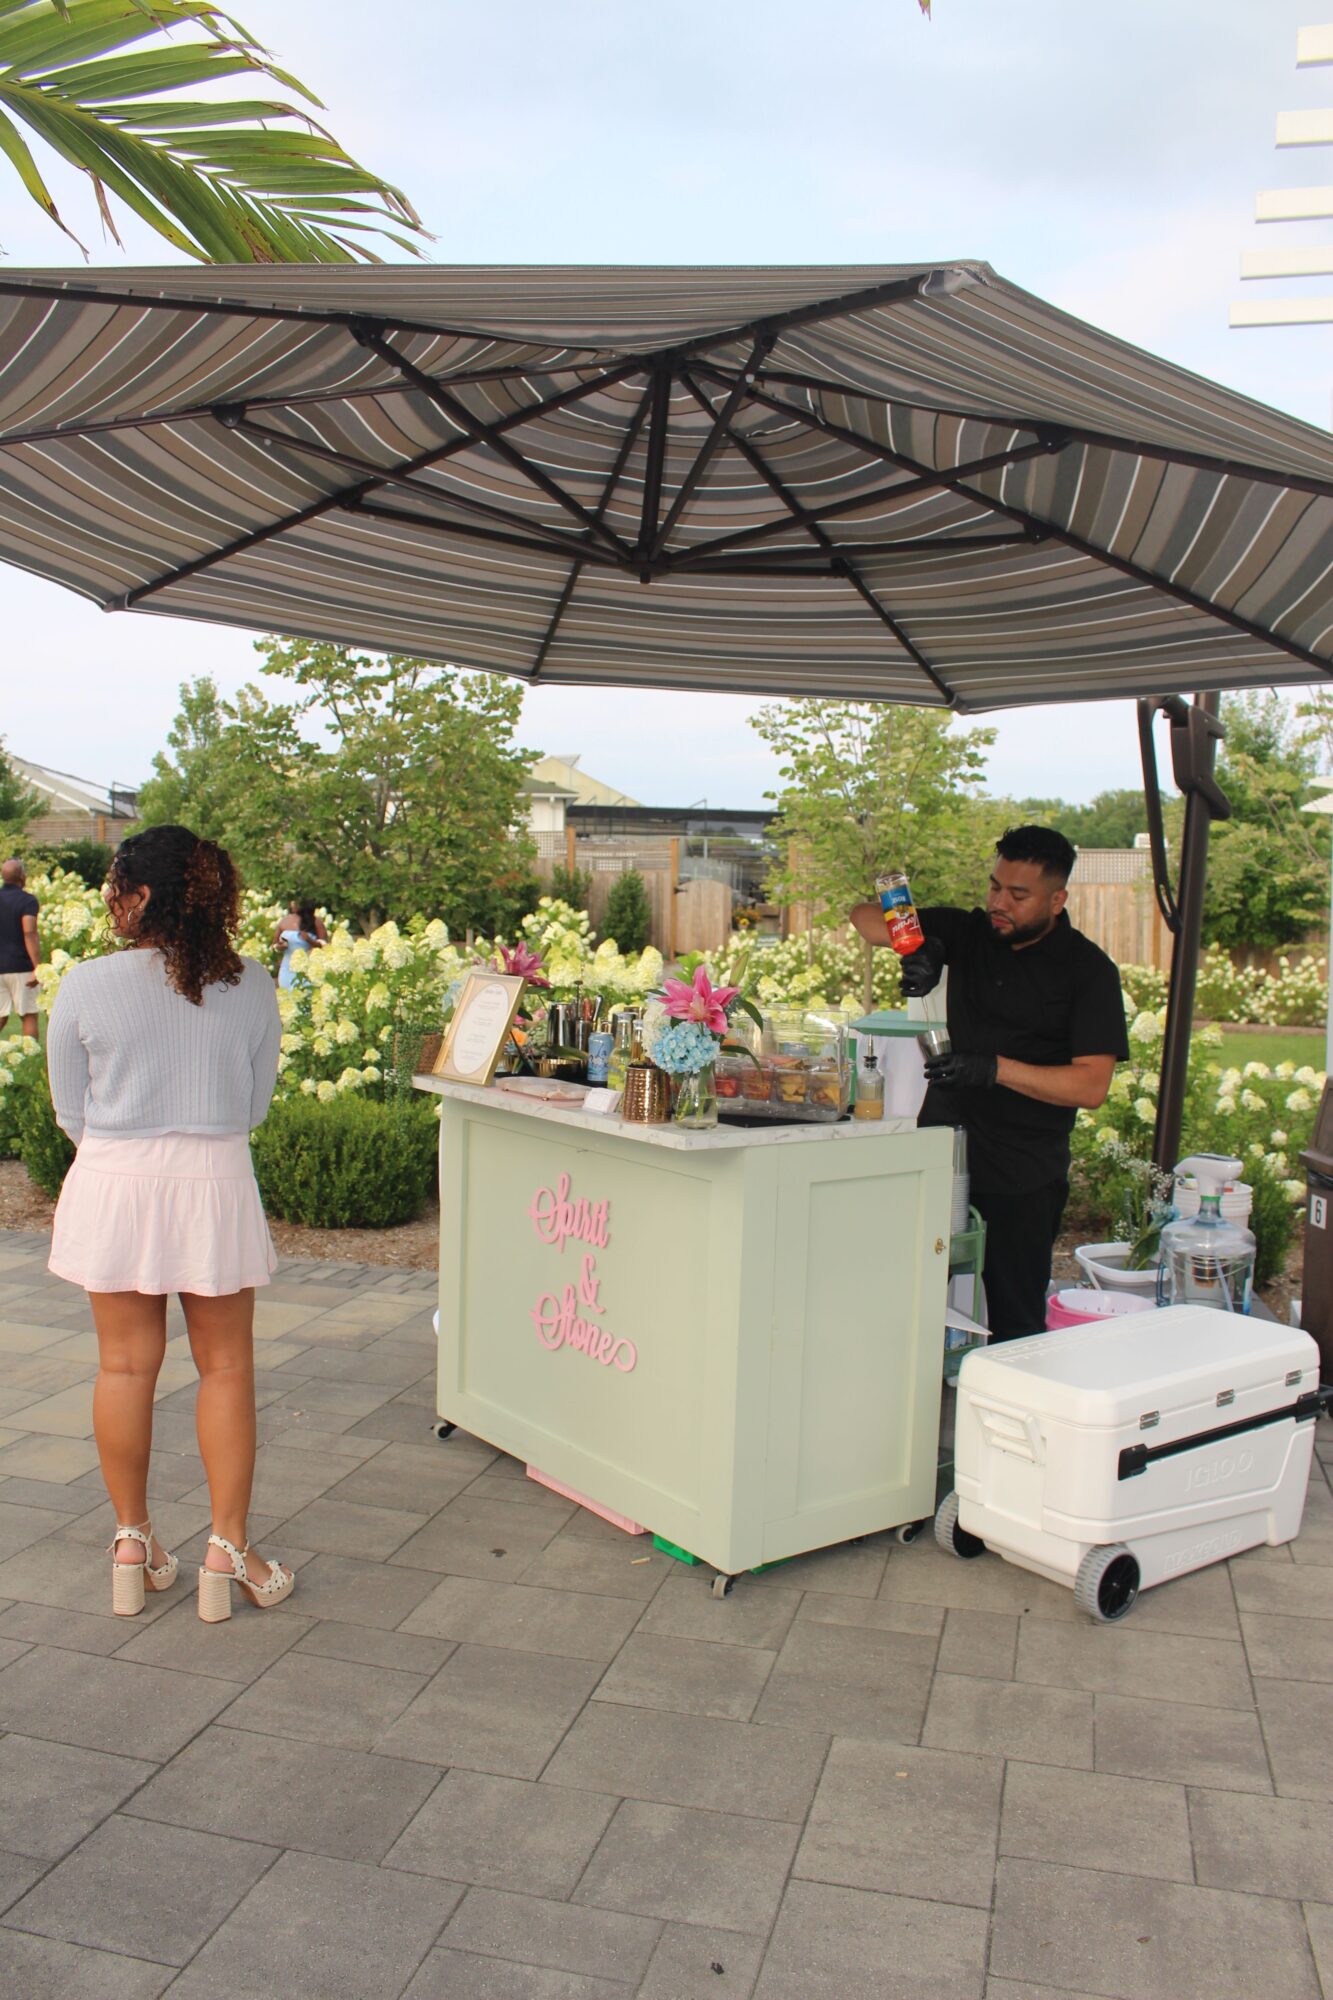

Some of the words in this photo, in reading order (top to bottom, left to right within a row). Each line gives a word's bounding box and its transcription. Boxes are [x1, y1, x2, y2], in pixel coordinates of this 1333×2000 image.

[892, 913, 920, 936] Torani
[527, 1172, 611, 1253] Spirit
[1315, 1199, 1323, 1225] 6
[580, 1253, 606, 1314] &
[1183, 1449, 1255, 1492] IGLOO
